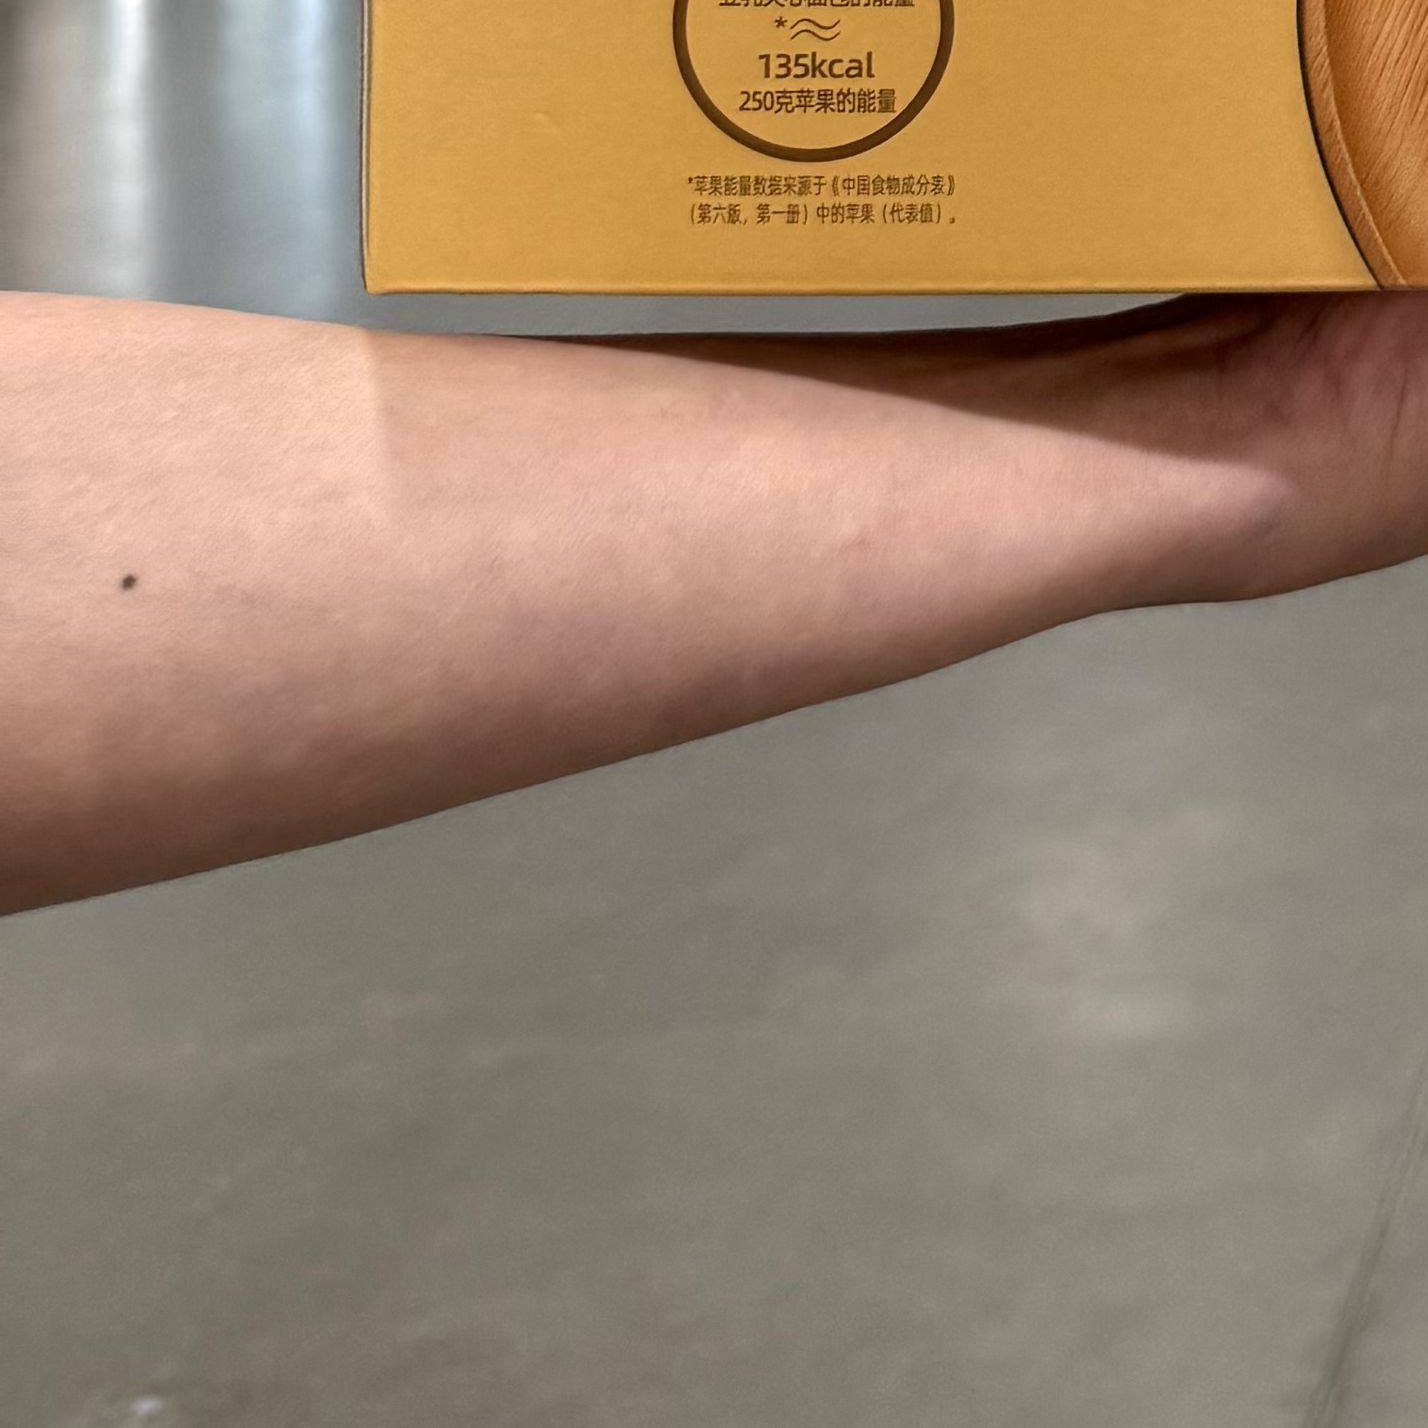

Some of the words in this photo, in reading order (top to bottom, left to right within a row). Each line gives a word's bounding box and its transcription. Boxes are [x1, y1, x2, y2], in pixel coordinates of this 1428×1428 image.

[758, 51, 875, 79] 135kcal
[738, 88, 896, 114] 250克苹果的能量
